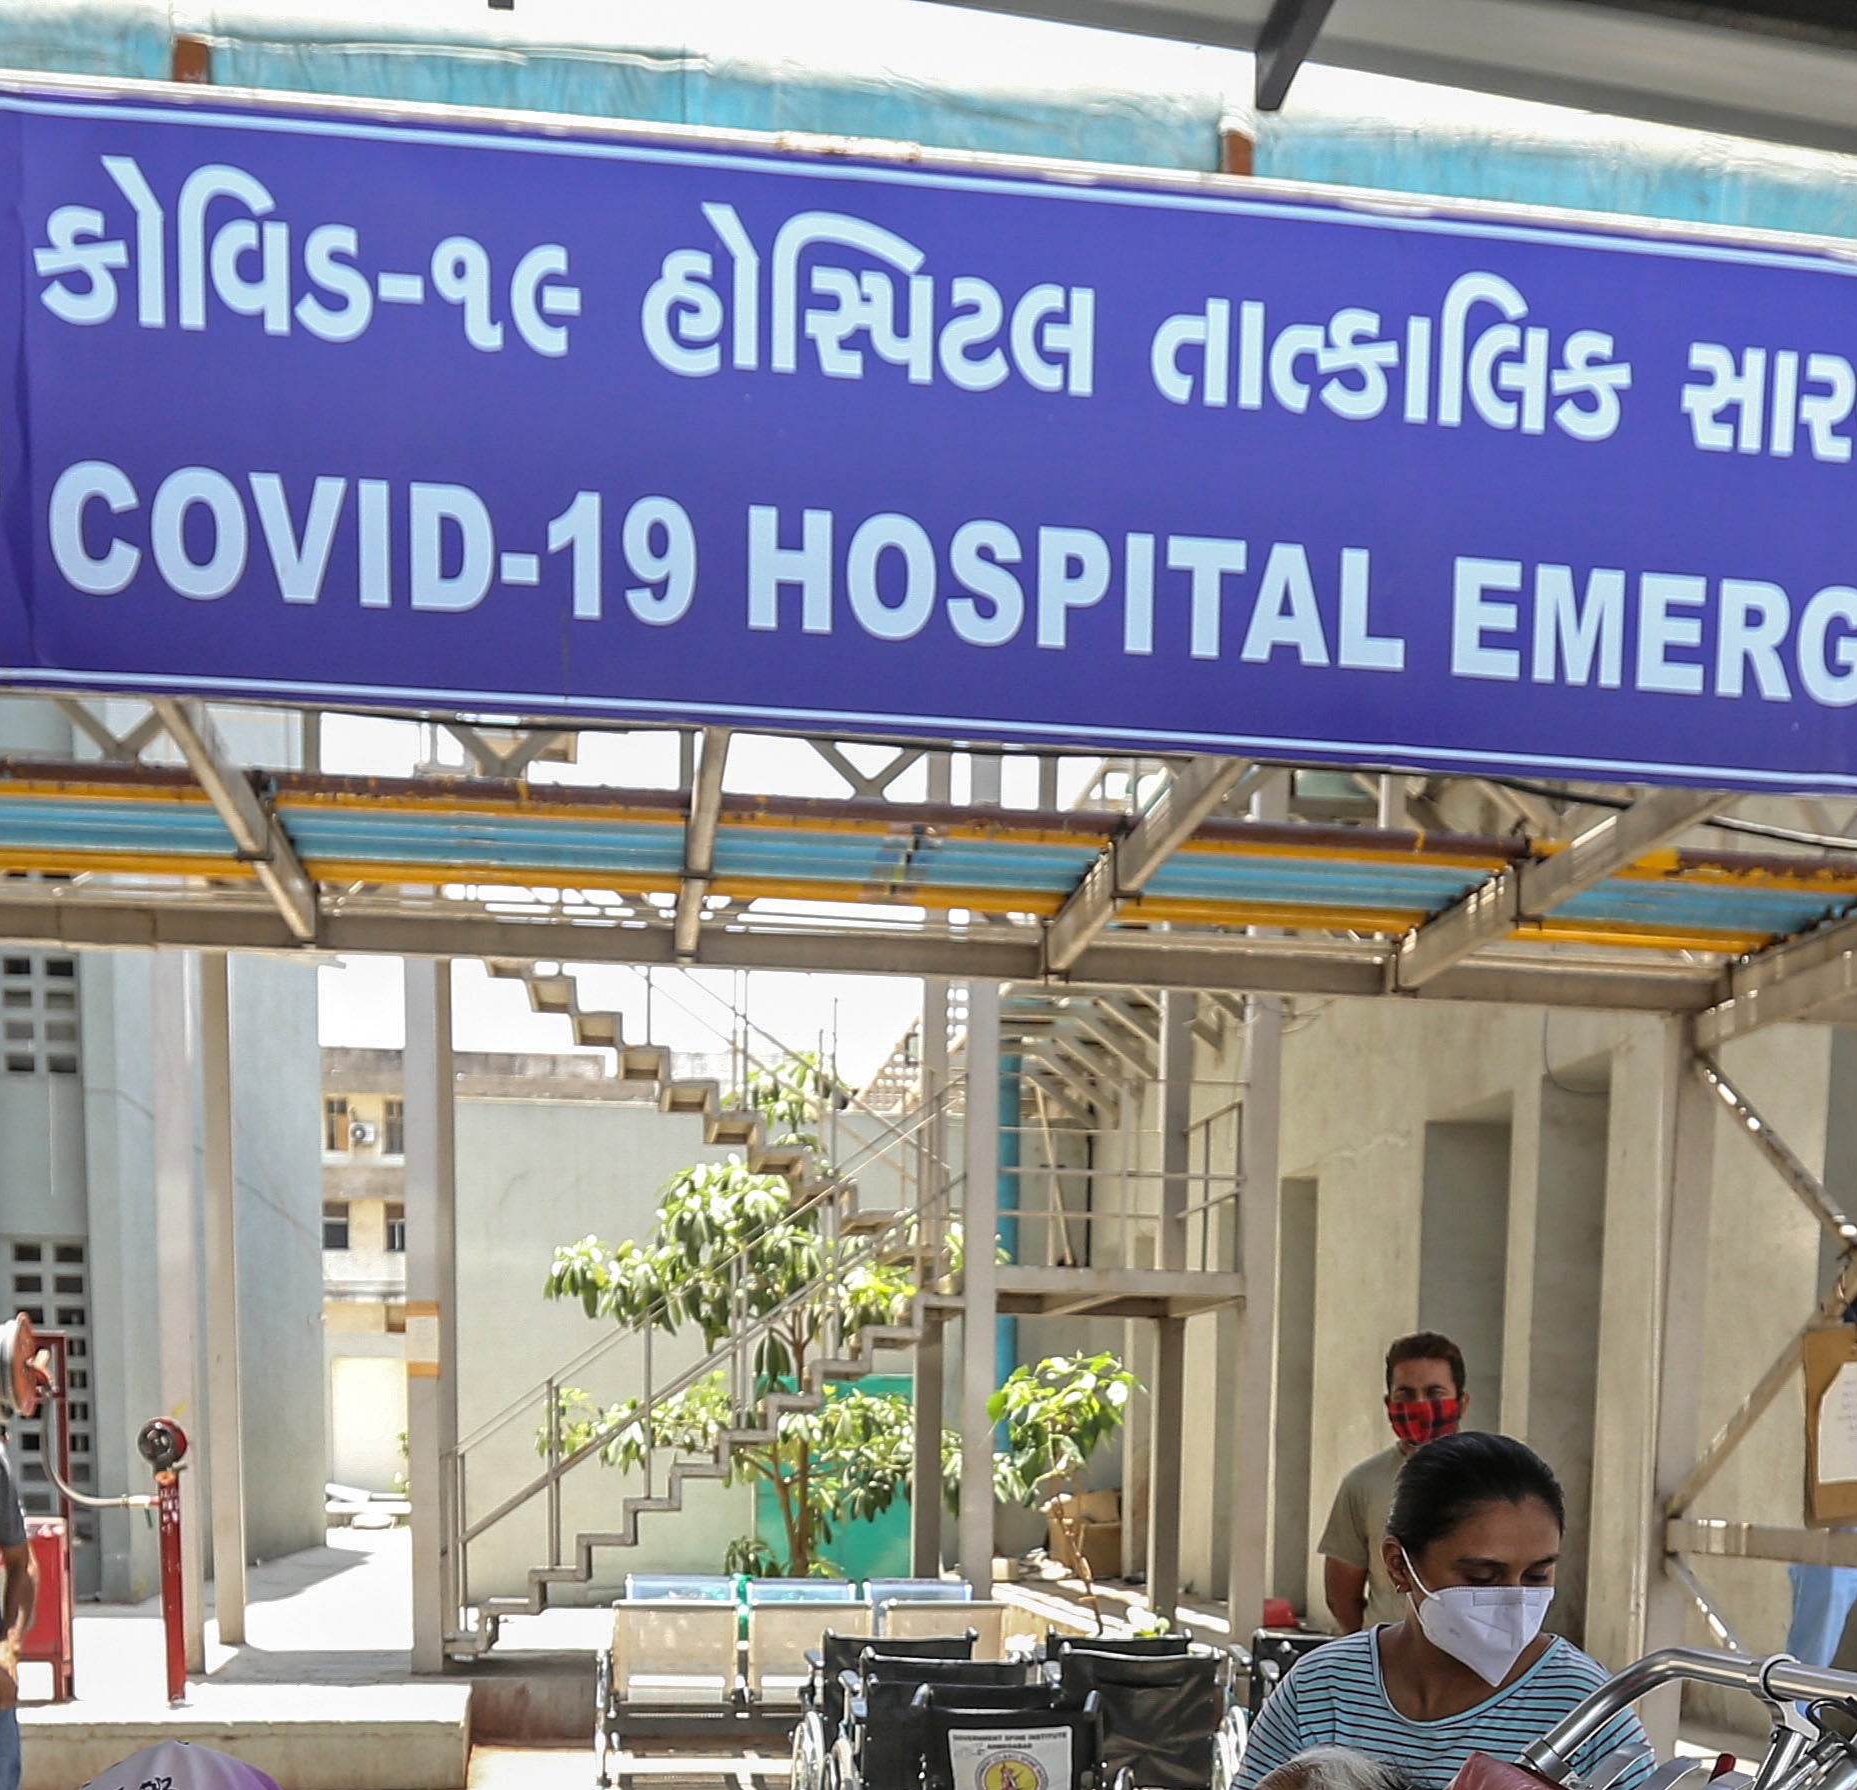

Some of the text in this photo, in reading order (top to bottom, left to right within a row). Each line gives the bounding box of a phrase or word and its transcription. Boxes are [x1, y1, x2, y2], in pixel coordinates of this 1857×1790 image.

[35, 155, 582, 356] કોવિડ-૧૯
[641, 202, 1096, 398] હોસ્પિટલ
[1150, 270, 1632, 442] તાત્કાલિક
[48, 461, 697, 624] COVID-19
[748, 504, 1406, 672] HOSPITAL
